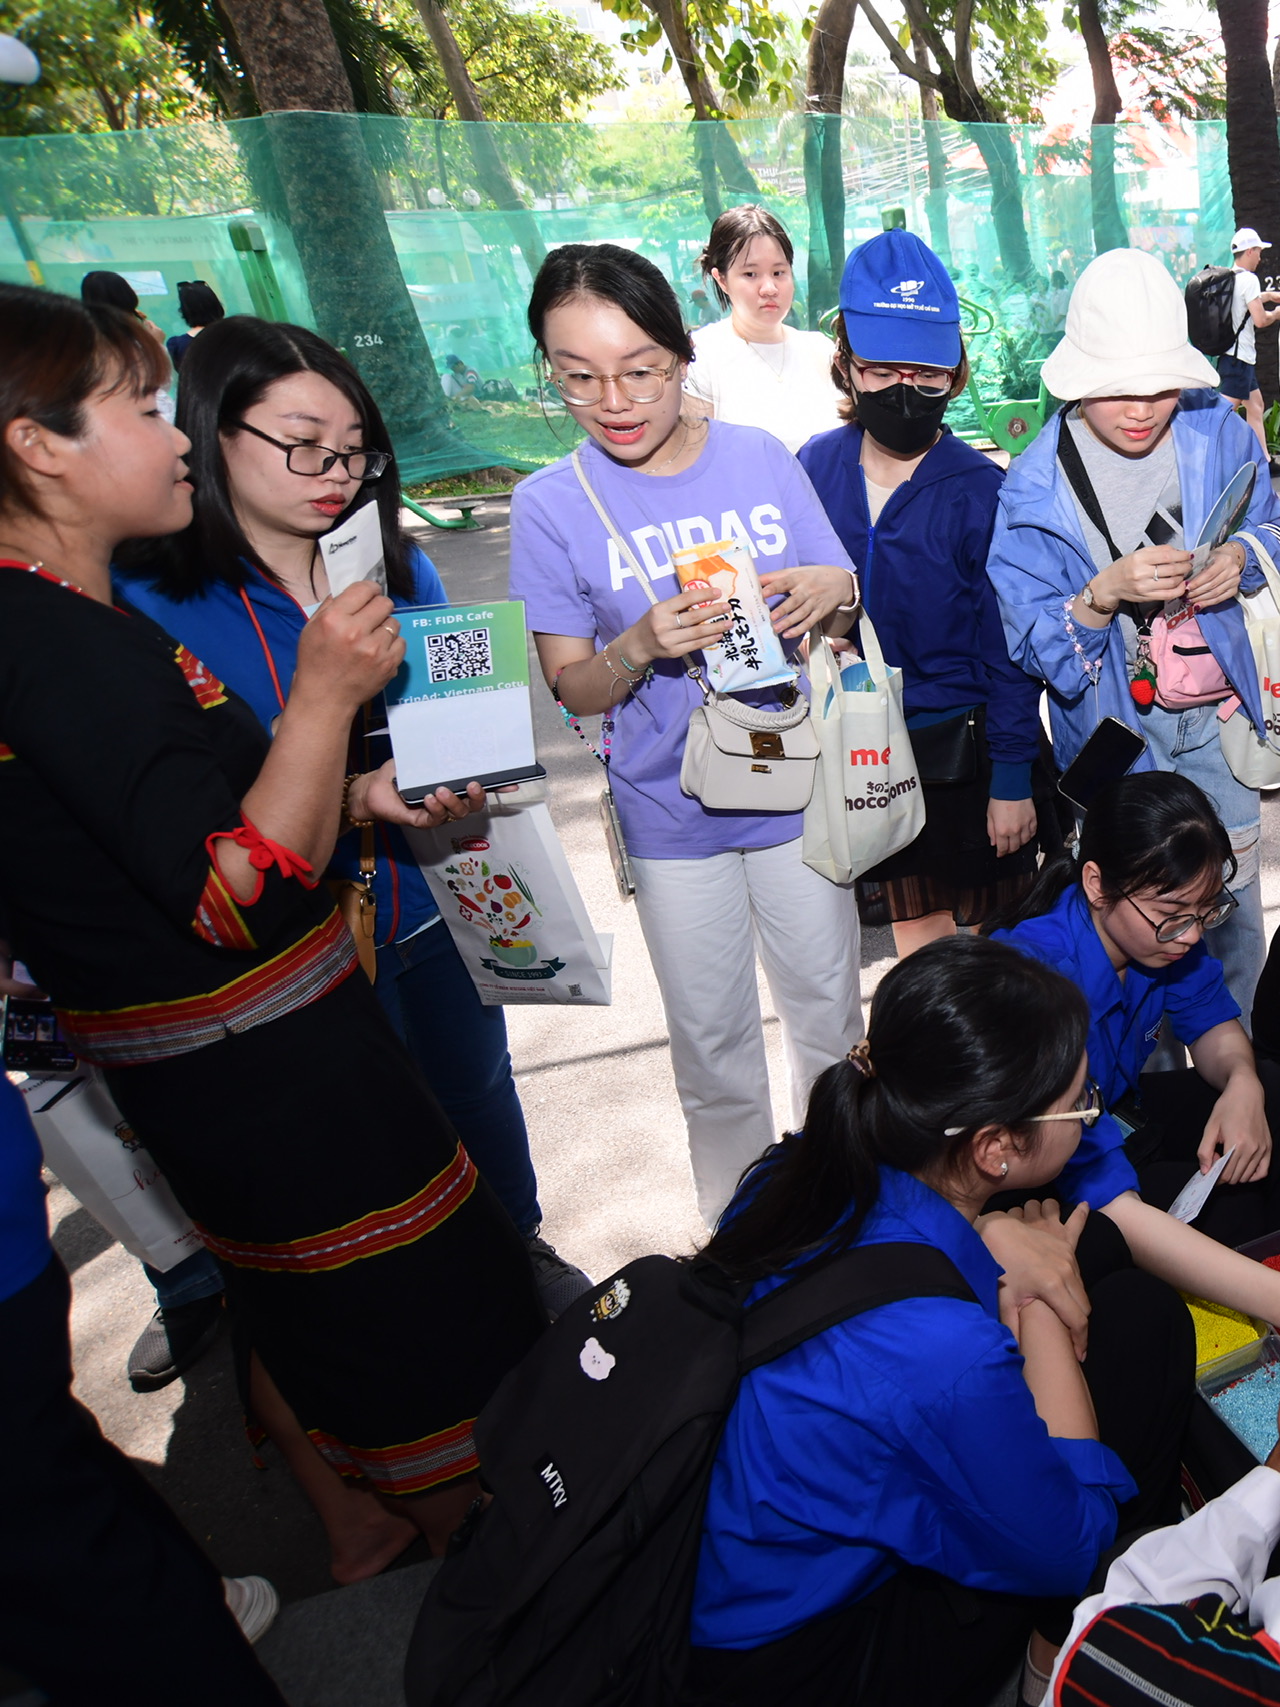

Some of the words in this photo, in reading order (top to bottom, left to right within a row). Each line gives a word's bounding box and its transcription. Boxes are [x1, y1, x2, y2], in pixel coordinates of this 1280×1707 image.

[354, 334, 384, 348] 234
[607, 504, 787, 592] ADIDAS
[413, 618, 432, 628] FB:
[435, 614, 464, 626] FIDR
[467, 610, 494, 622] Cafe
[444, 685, 494, 698] Vietnam
[497, 680, 524, 691] Cotu
[851, 747, 891, 766] me
[504, 970, 526, 978] SINCE
